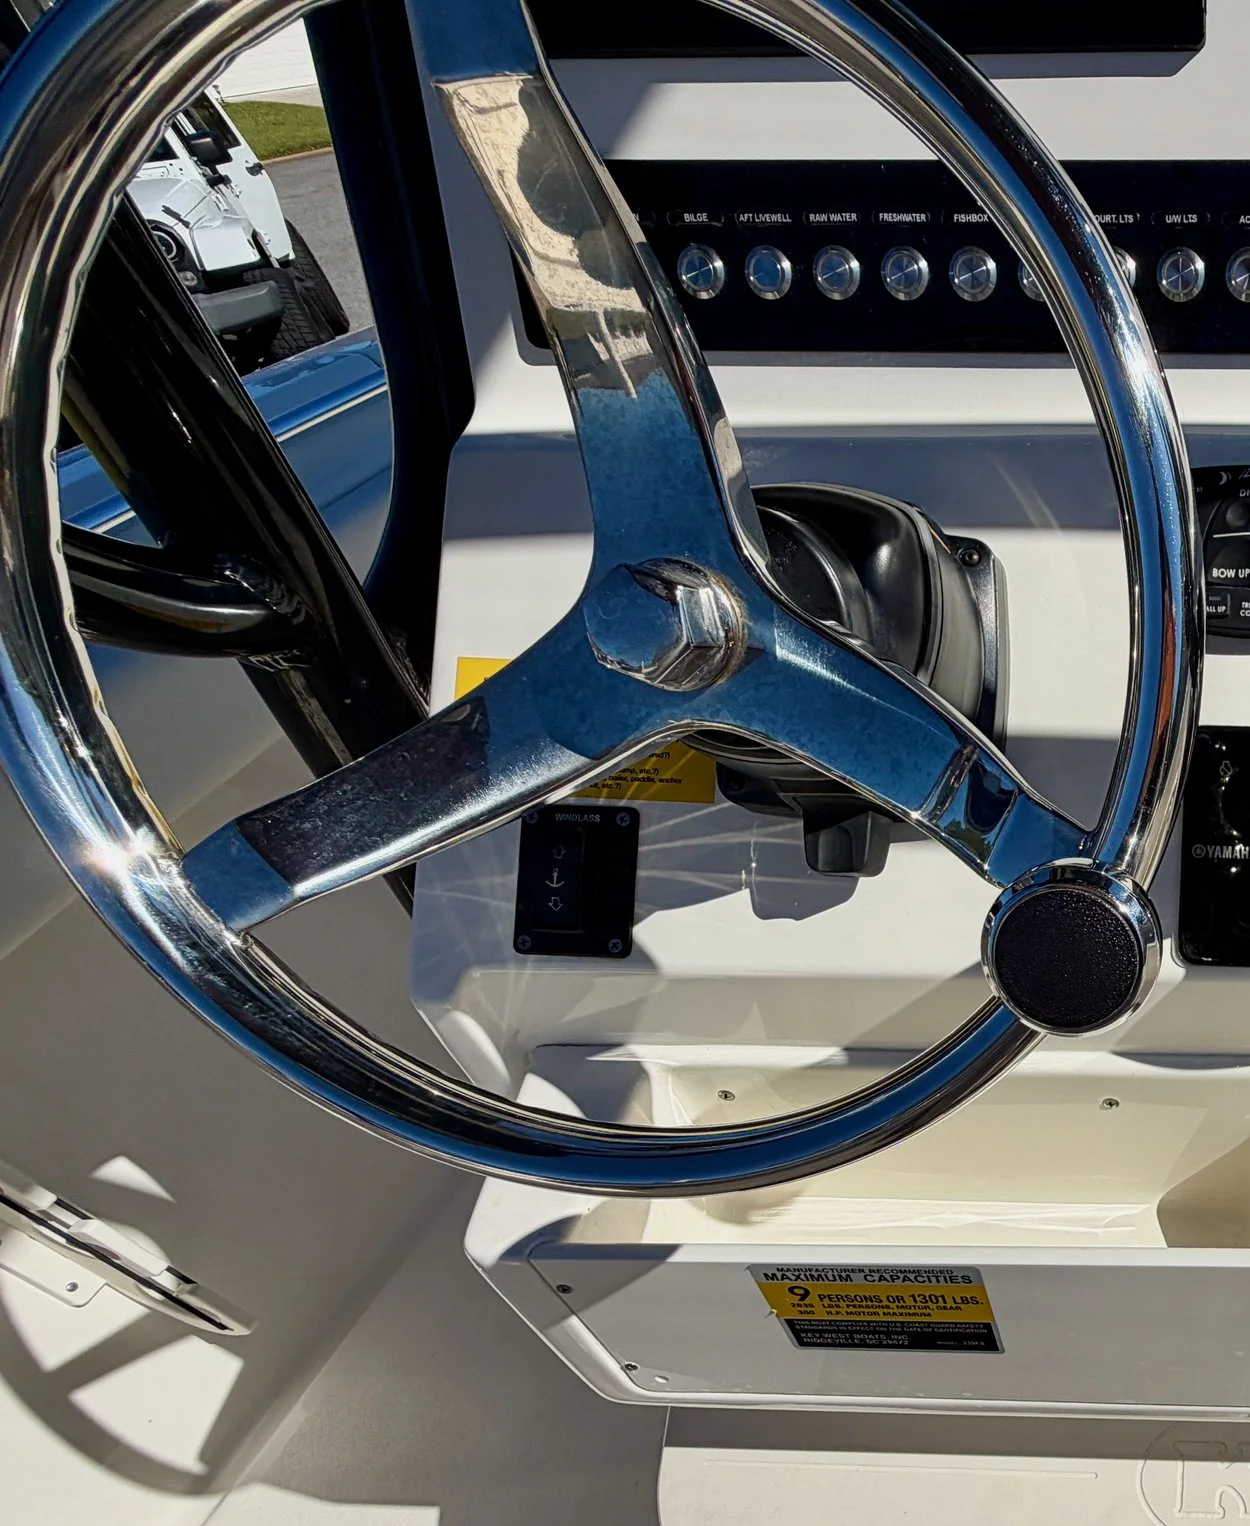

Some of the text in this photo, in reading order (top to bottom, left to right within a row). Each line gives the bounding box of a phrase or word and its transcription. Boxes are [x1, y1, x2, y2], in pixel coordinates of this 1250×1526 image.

[683, 212, 709, 222] BILGE
[739, 213, 792, 222] AFT LIVEWELL
[809, 213, 858, 222] RAW WATER
[879, 213, 927, 222] FRESHWATER
[953, 213, 990, 223] FISHBOX
[1094, 213, 1134, 224] OURT. LTS
[1165, 214, 1198, 223] U/W LTS
[1212, 568, 1250, 578] BOW UP
[1217, 605, 1227, 613] UP
[555, 813, 601, 823] WINDLASS
[762, 1272, 973, 1284] MAXIMUM CAPACITIES
[787, 1285, 984, 1305] 9 PERSONS OR 1301 LBS.
